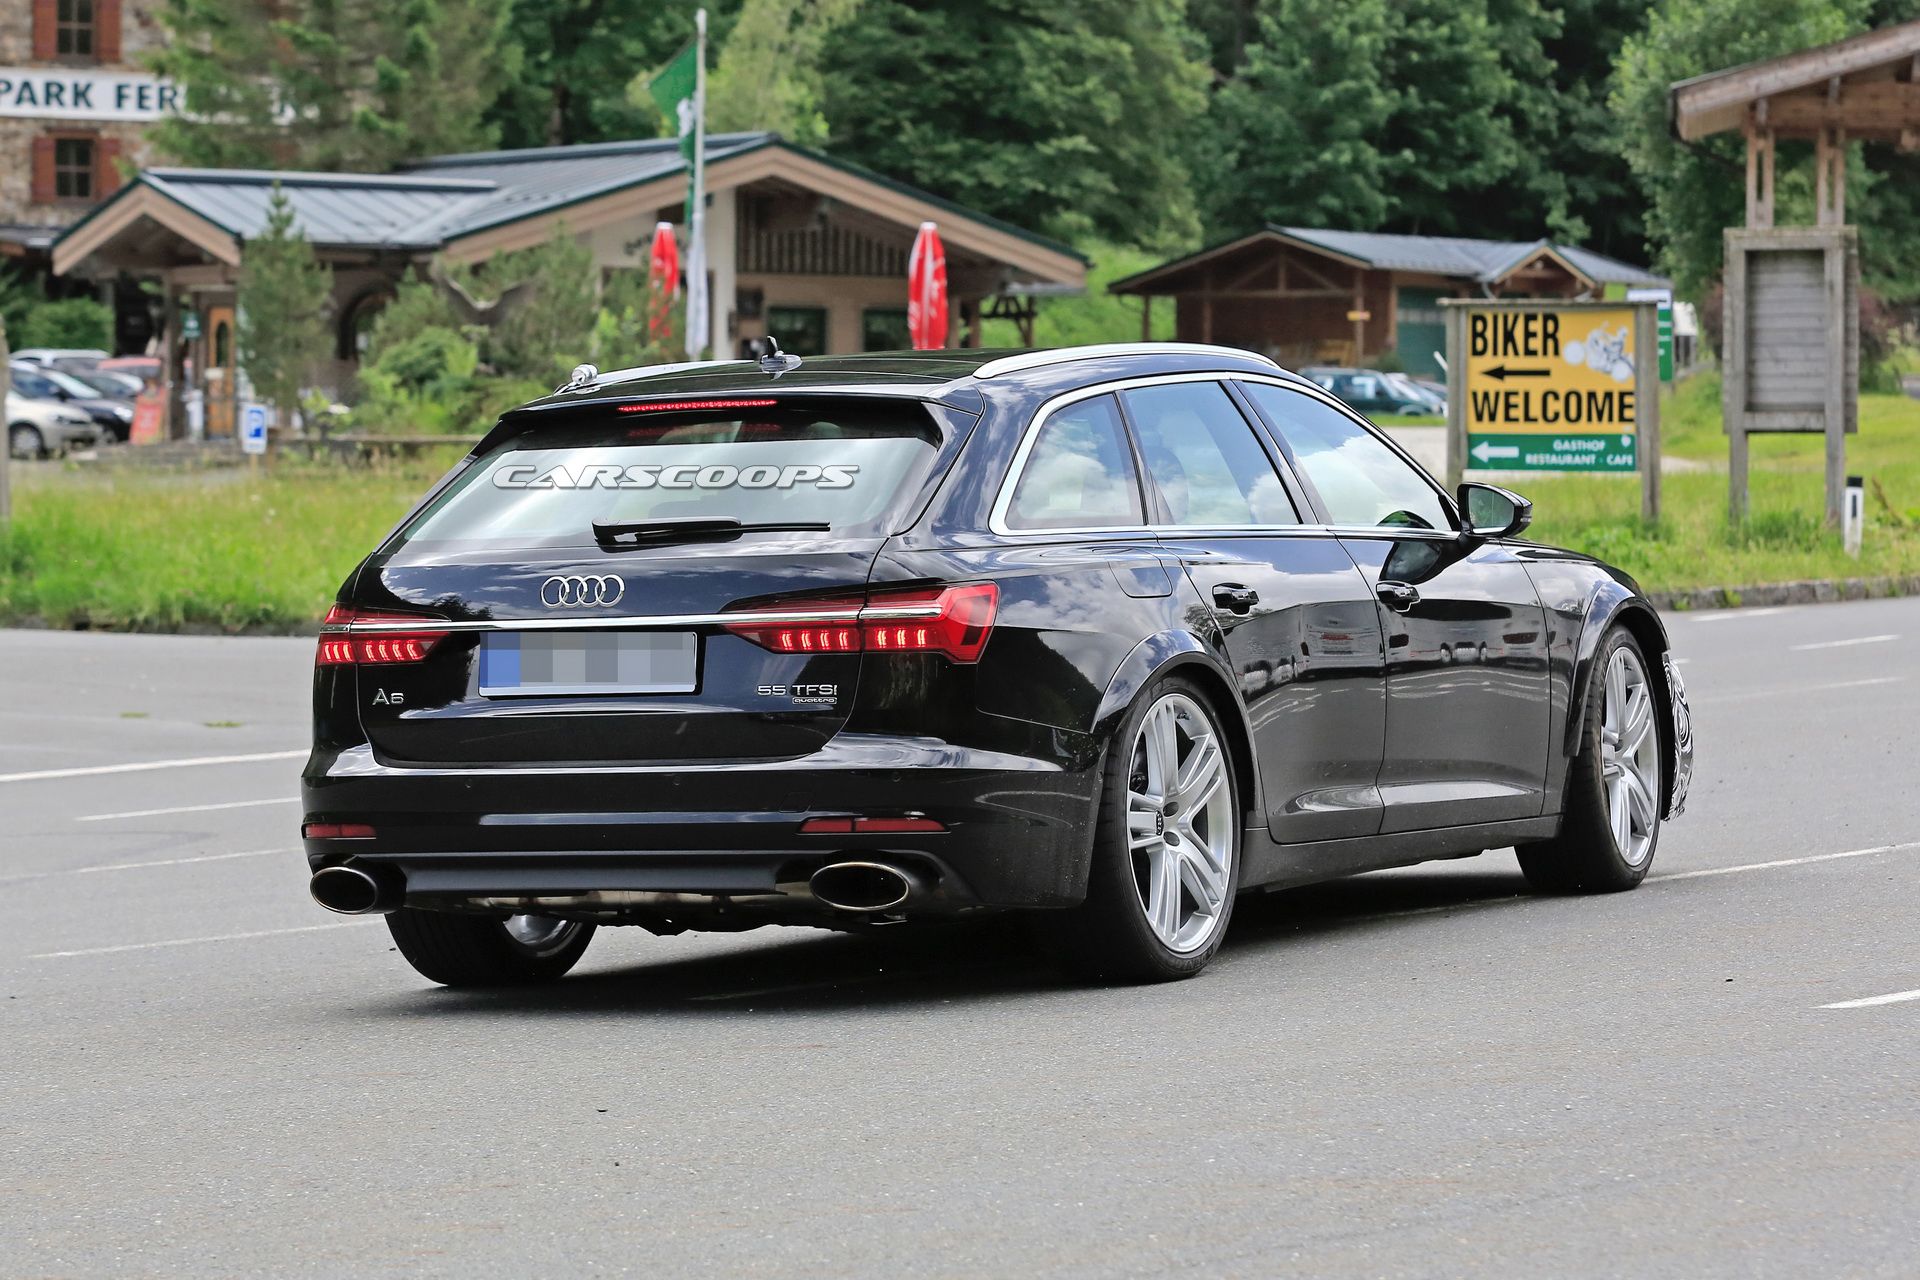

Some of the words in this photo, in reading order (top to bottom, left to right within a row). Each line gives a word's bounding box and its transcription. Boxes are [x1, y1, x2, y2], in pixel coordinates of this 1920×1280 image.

[0, 79, 94, 108] PARK
[114, 83, 179, 111] FER
[1471, 313, 1560, 357] BIKER
[1472, 390, 1635, 423] WELCOME
[1552, 439, 1605, 452] GASTHOF
[1525, 453, 1596, 466] RESTAURANT
[1606, 454, 1634, 466] CAFE
[372, 688, 405, 705] A6
[757, 684, 787, 696] 55
[792, 684, 838, 696] TFSI
[794, 696, 835, 704] quattro
